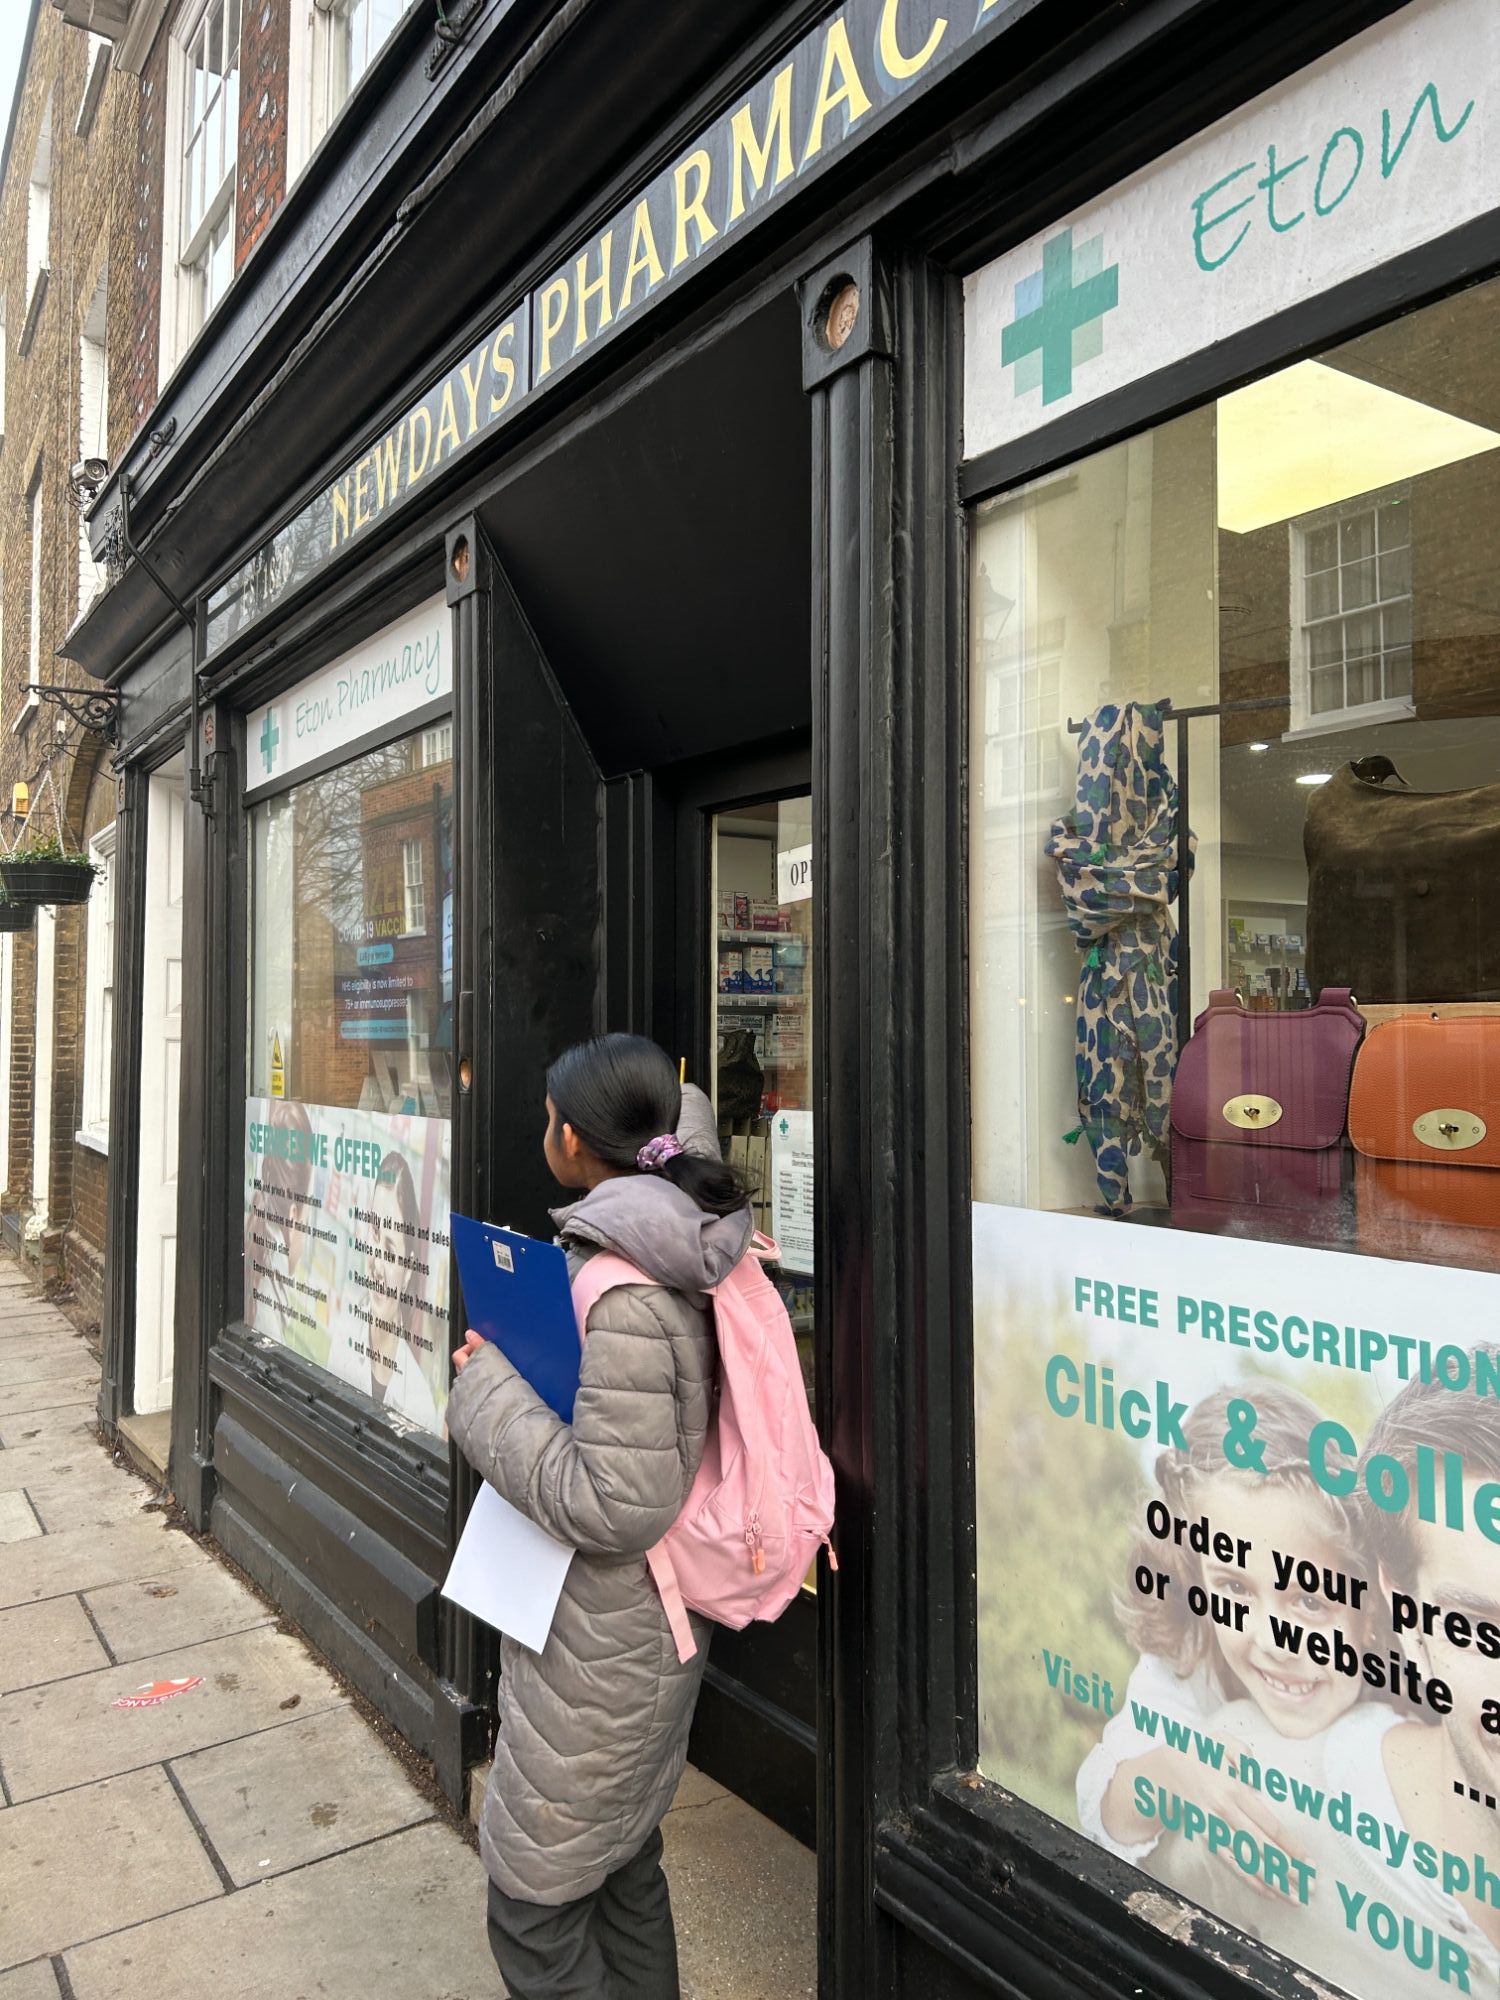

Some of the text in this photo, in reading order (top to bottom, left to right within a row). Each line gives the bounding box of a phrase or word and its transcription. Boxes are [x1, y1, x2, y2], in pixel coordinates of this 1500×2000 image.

[1191, 82, 1475, 271] Eton
[330, 0, 998, 549] NEWDAYS PHARMAC
[296, 629, 441, 738] Eton Pharmacy
[791, 860, 812, 886] OP
[388, 975, 407, 989] limited
[407, 975, 414, 987] to
[249, 1122, 306, 1163] SERVICES
[307, 1133, 328, 1168] WE
[253, 1205, 266, 1219] Travel
[285, 1218, 293, 1229] and
[312, 1227, 338, 1245] prevention
[265, 1236, 277, 1251] travel
[278, 1241, 290, 1256] clinic
[354, 1206, 450, 1248] Motability aid rentals and sales
[354, 1237, 430, 1276] Advice on new medicines
[354, 1271, 385, 1294] Residential
[386, 1286, 398, 1300] and
[399, 1291, 413, 1307] care
[415, 1295, 433, 1315] home
[300, 1313, 317, 1330] service
[354, 1305, 434, 1353] Private consultation rooms
[1074, 1276, 1500, 1401] FREE PRESCRIPTION
[354, 1340, 364, 1355] and
[366, 1344, 382, 1363] much
[1045, 1354, 1190, 1452] Click
[1222, 1398, 1270, 1475] &
[1146, 1500, 1500, 1660] Order your pres
[1134, 1564, 1170, 1601] or
[1188, 1584, 1250, 1632] our
[1269, 1615, 1454, 1715] website
[1042, 1648, 1500, 1910] Visit www.newdaysph
[1134, 1775, 1473, 1995] SUPPORT YOUR
